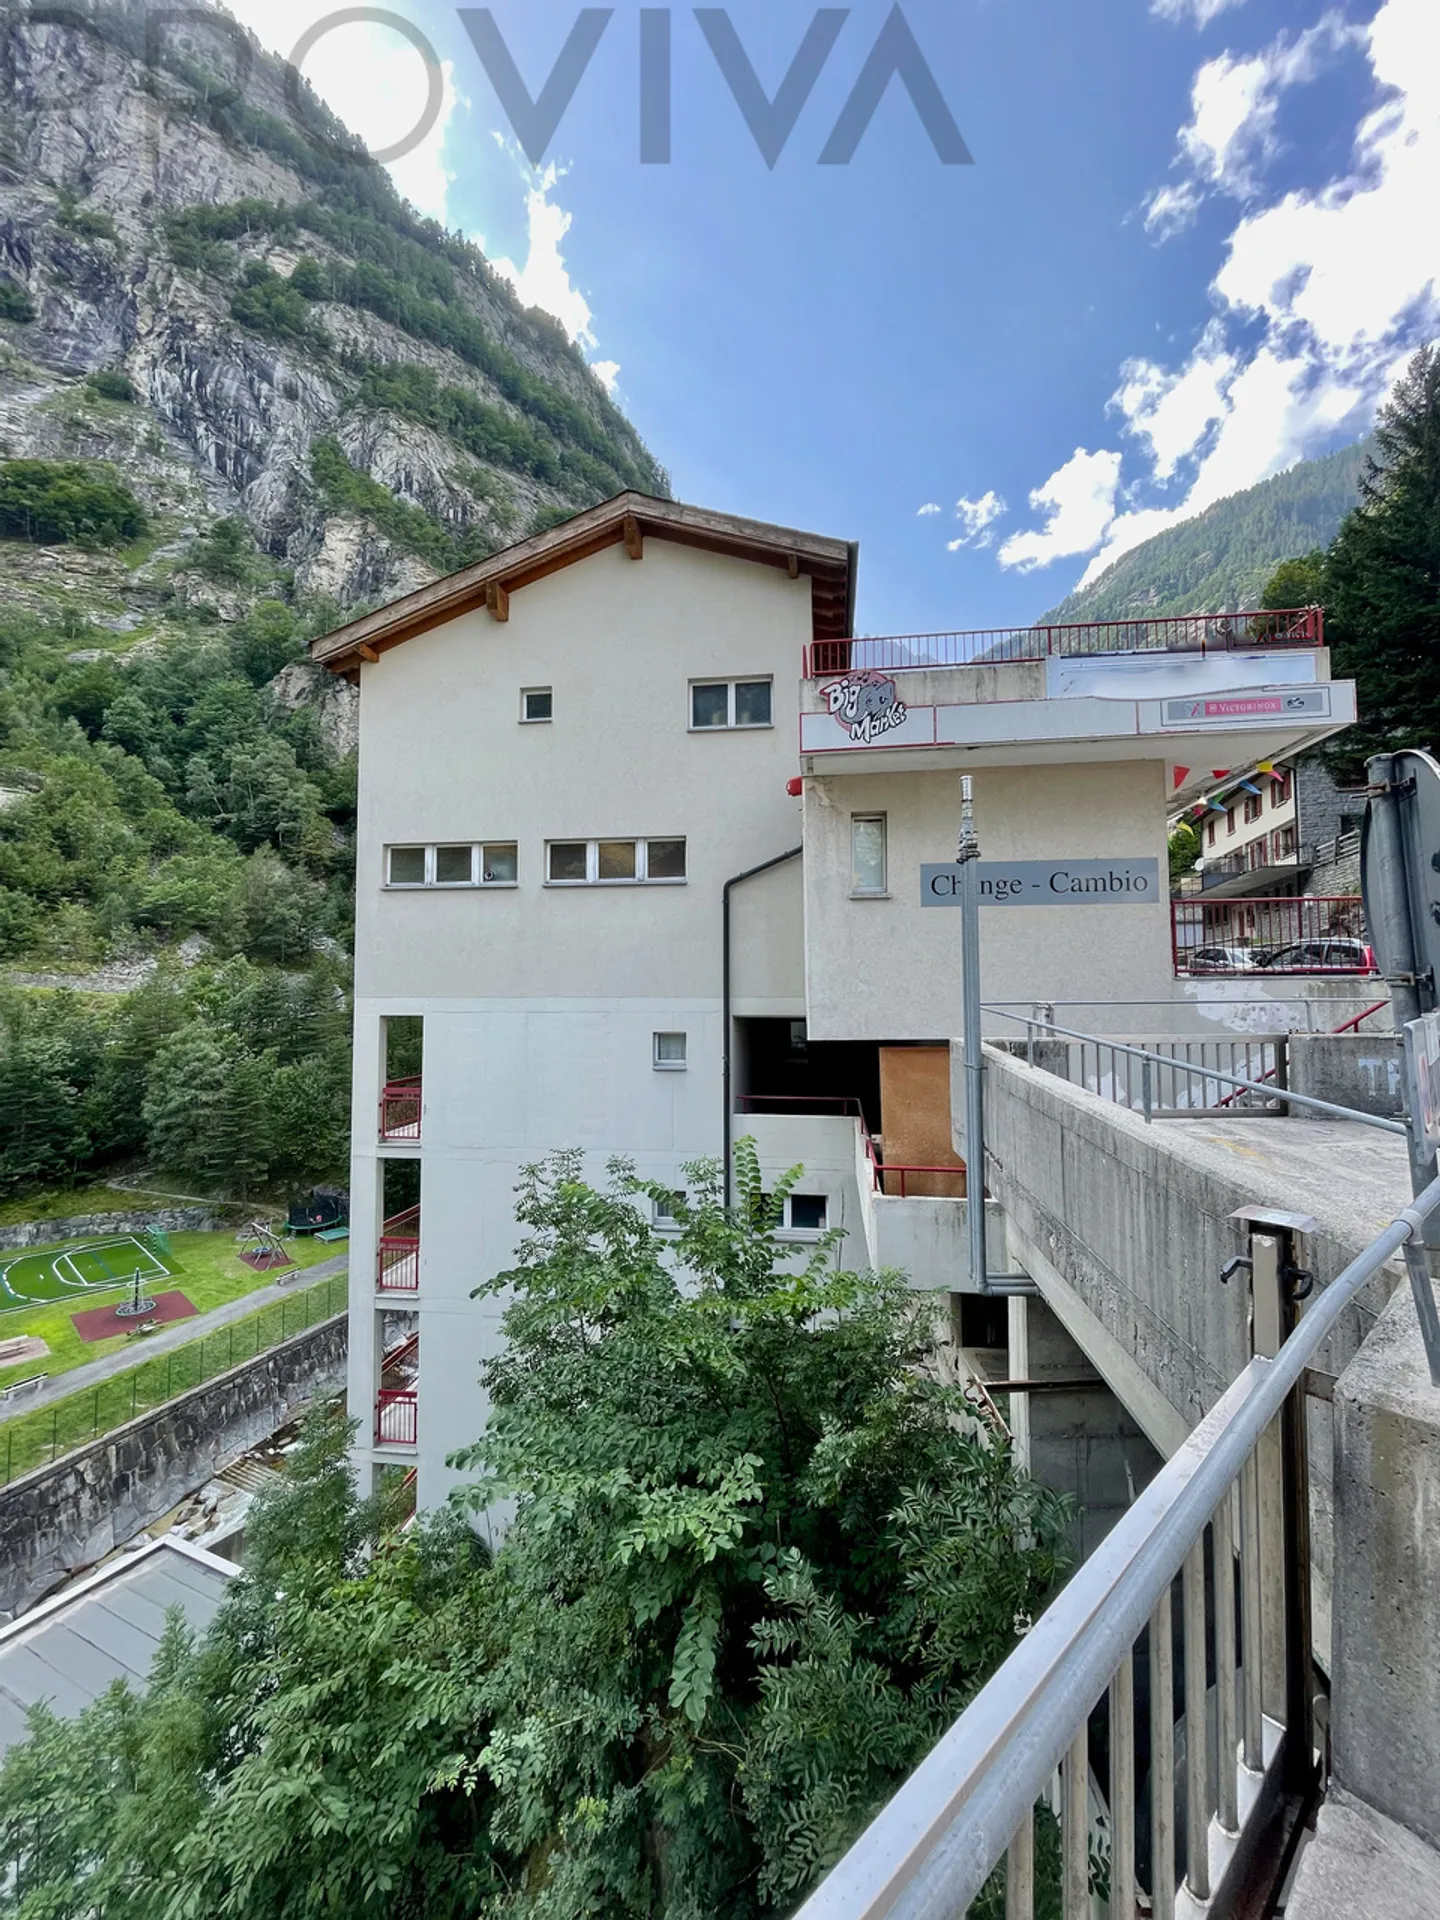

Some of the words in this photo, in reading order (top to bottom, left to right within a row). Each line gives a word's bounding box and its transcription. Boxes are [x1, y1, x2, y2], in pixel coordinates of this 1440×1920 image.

[824, 680, 861, 718] Big
[851, 702, 907, 742] Market
[931, 874, 1023, 901] Chnge
[1049, 870, 1149, 893] Cambio
